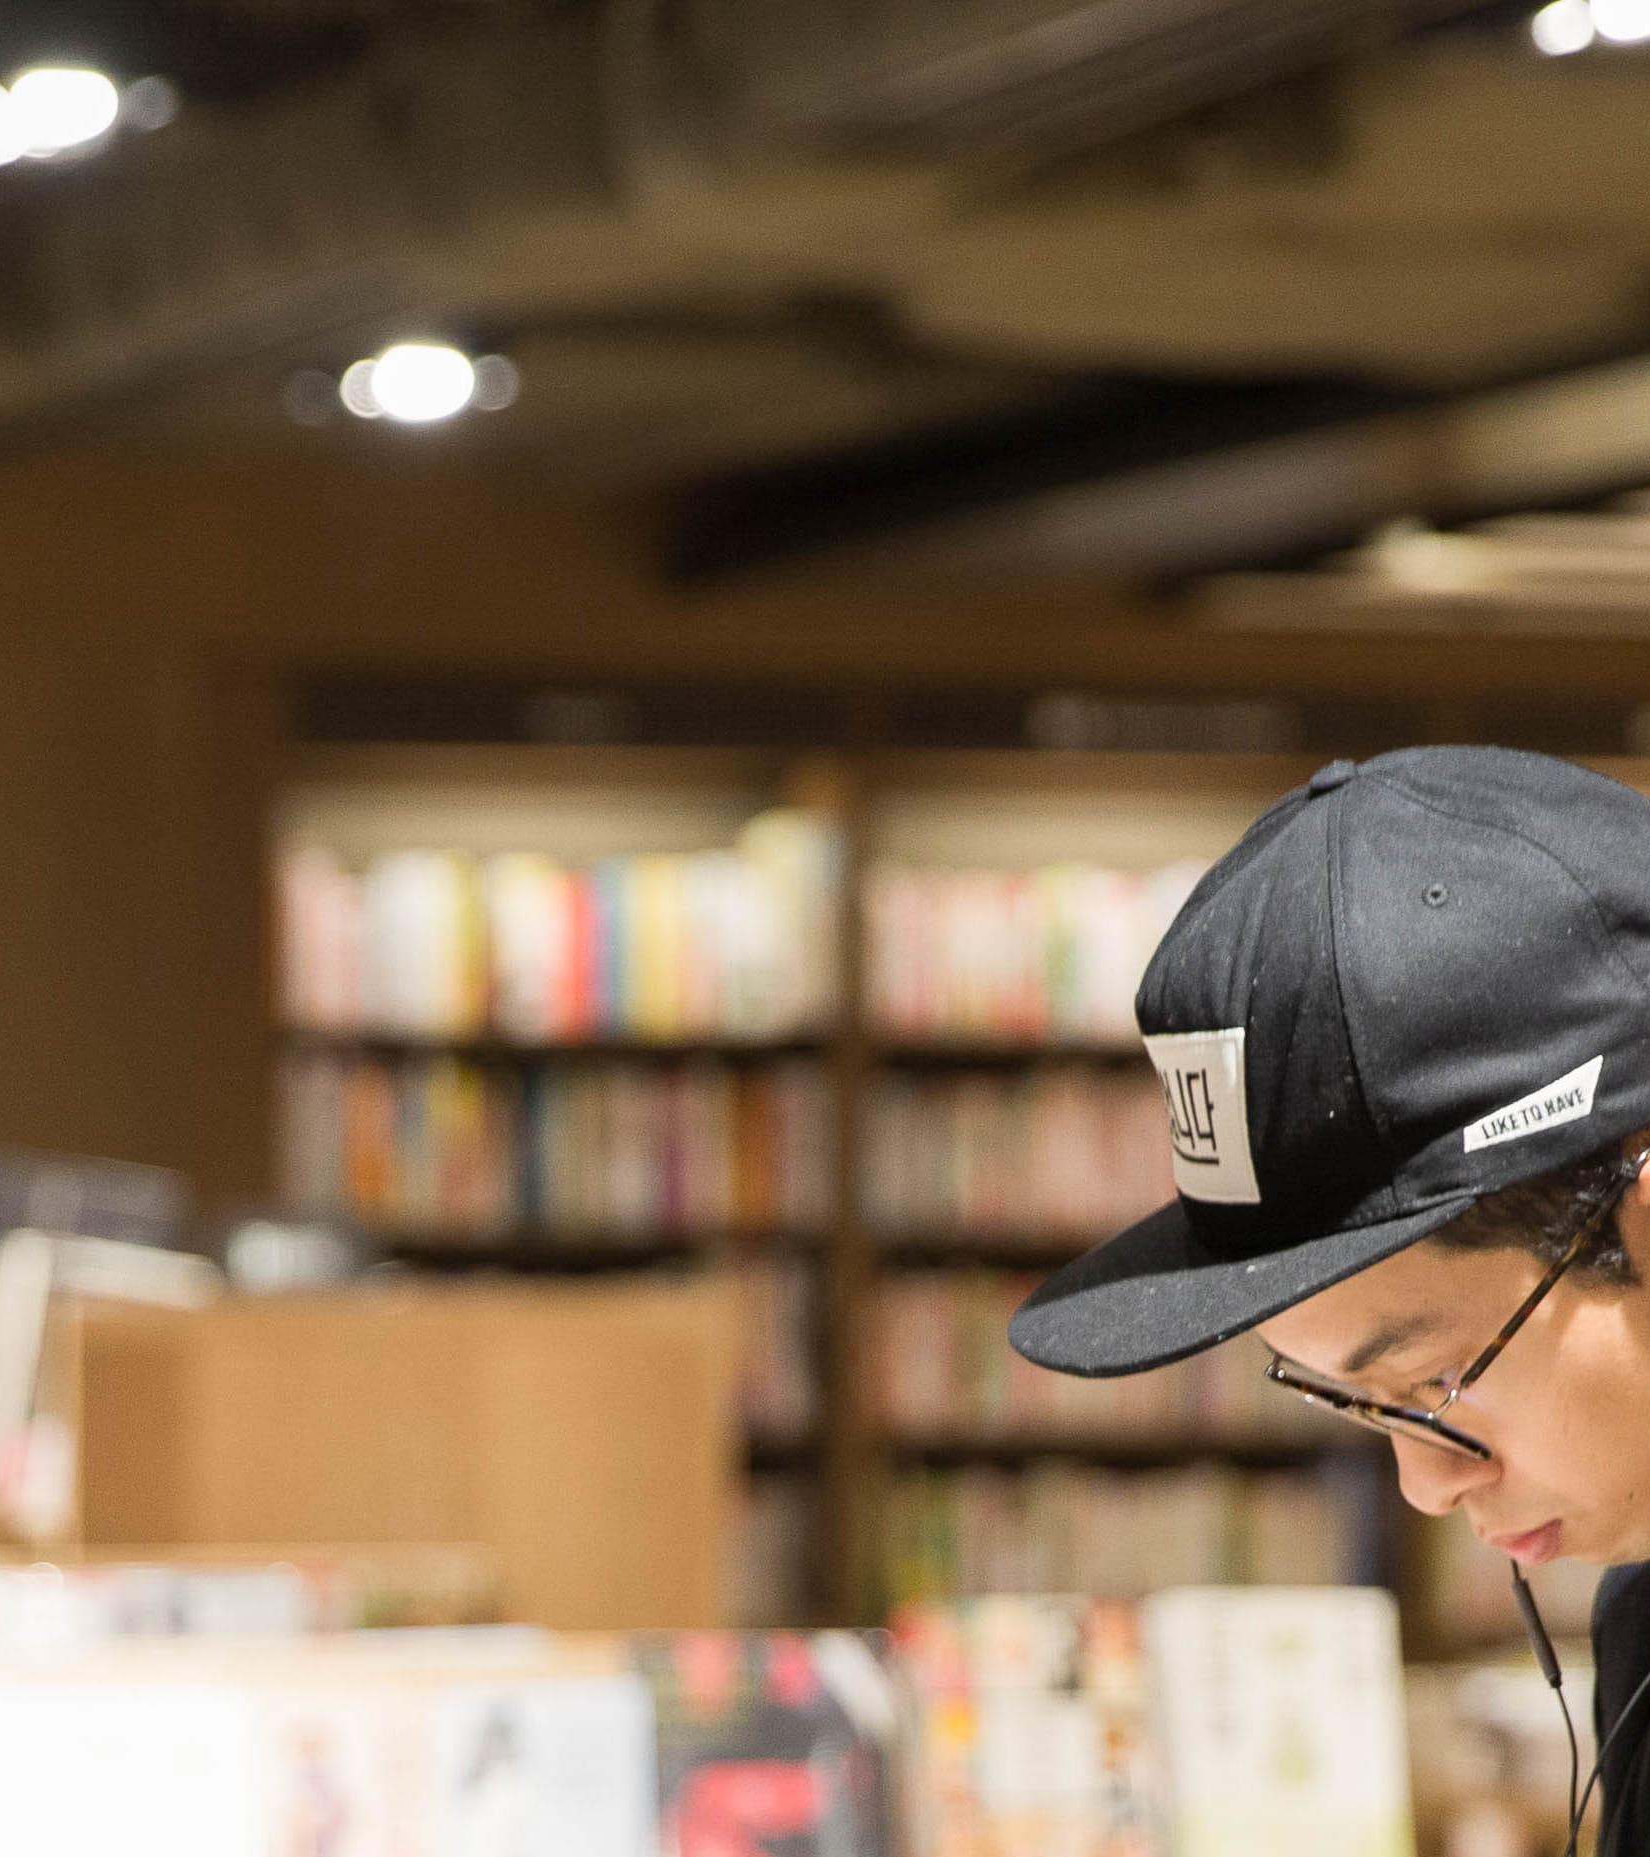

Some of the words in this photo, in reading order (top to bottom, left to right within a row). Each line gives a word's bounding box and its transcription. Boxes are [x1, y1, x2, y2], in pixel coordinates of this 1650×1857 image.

[1481, 1114, 1520, 1140] LIKE
[1522, 1105, 1543, 1126] TO
[1544, 1088, 1585, 1114] HAVE
